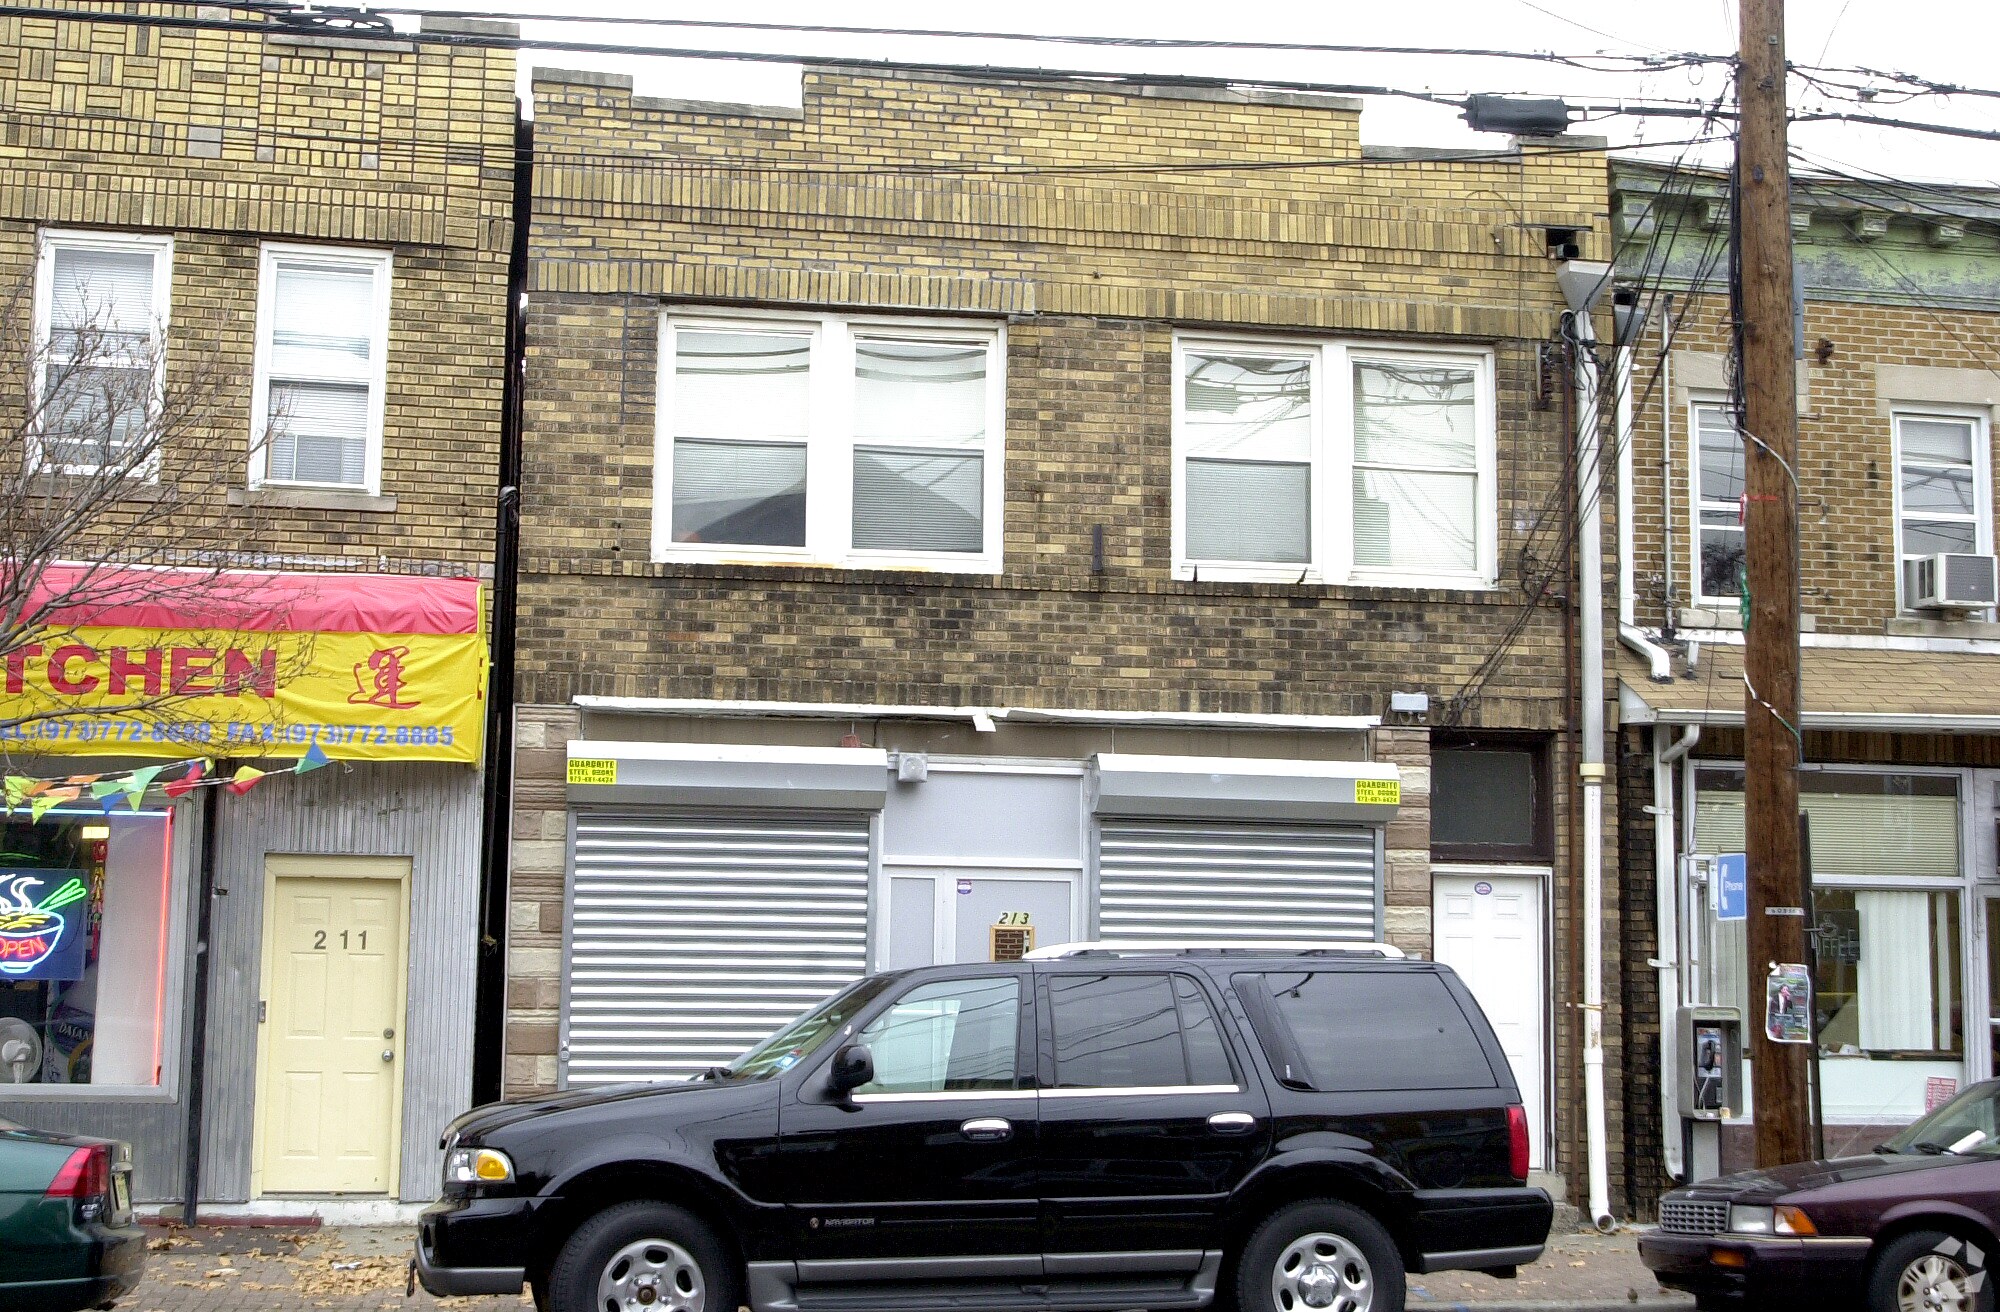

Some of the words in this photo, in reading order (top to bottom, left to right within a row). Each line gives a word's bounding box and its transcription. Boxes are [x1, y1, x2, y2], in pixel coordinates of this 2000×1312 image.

[3, 643, 278, 698] TCHEN
[998, 911, 1030, 925] 213
[314, 929, 367, 950] 211
